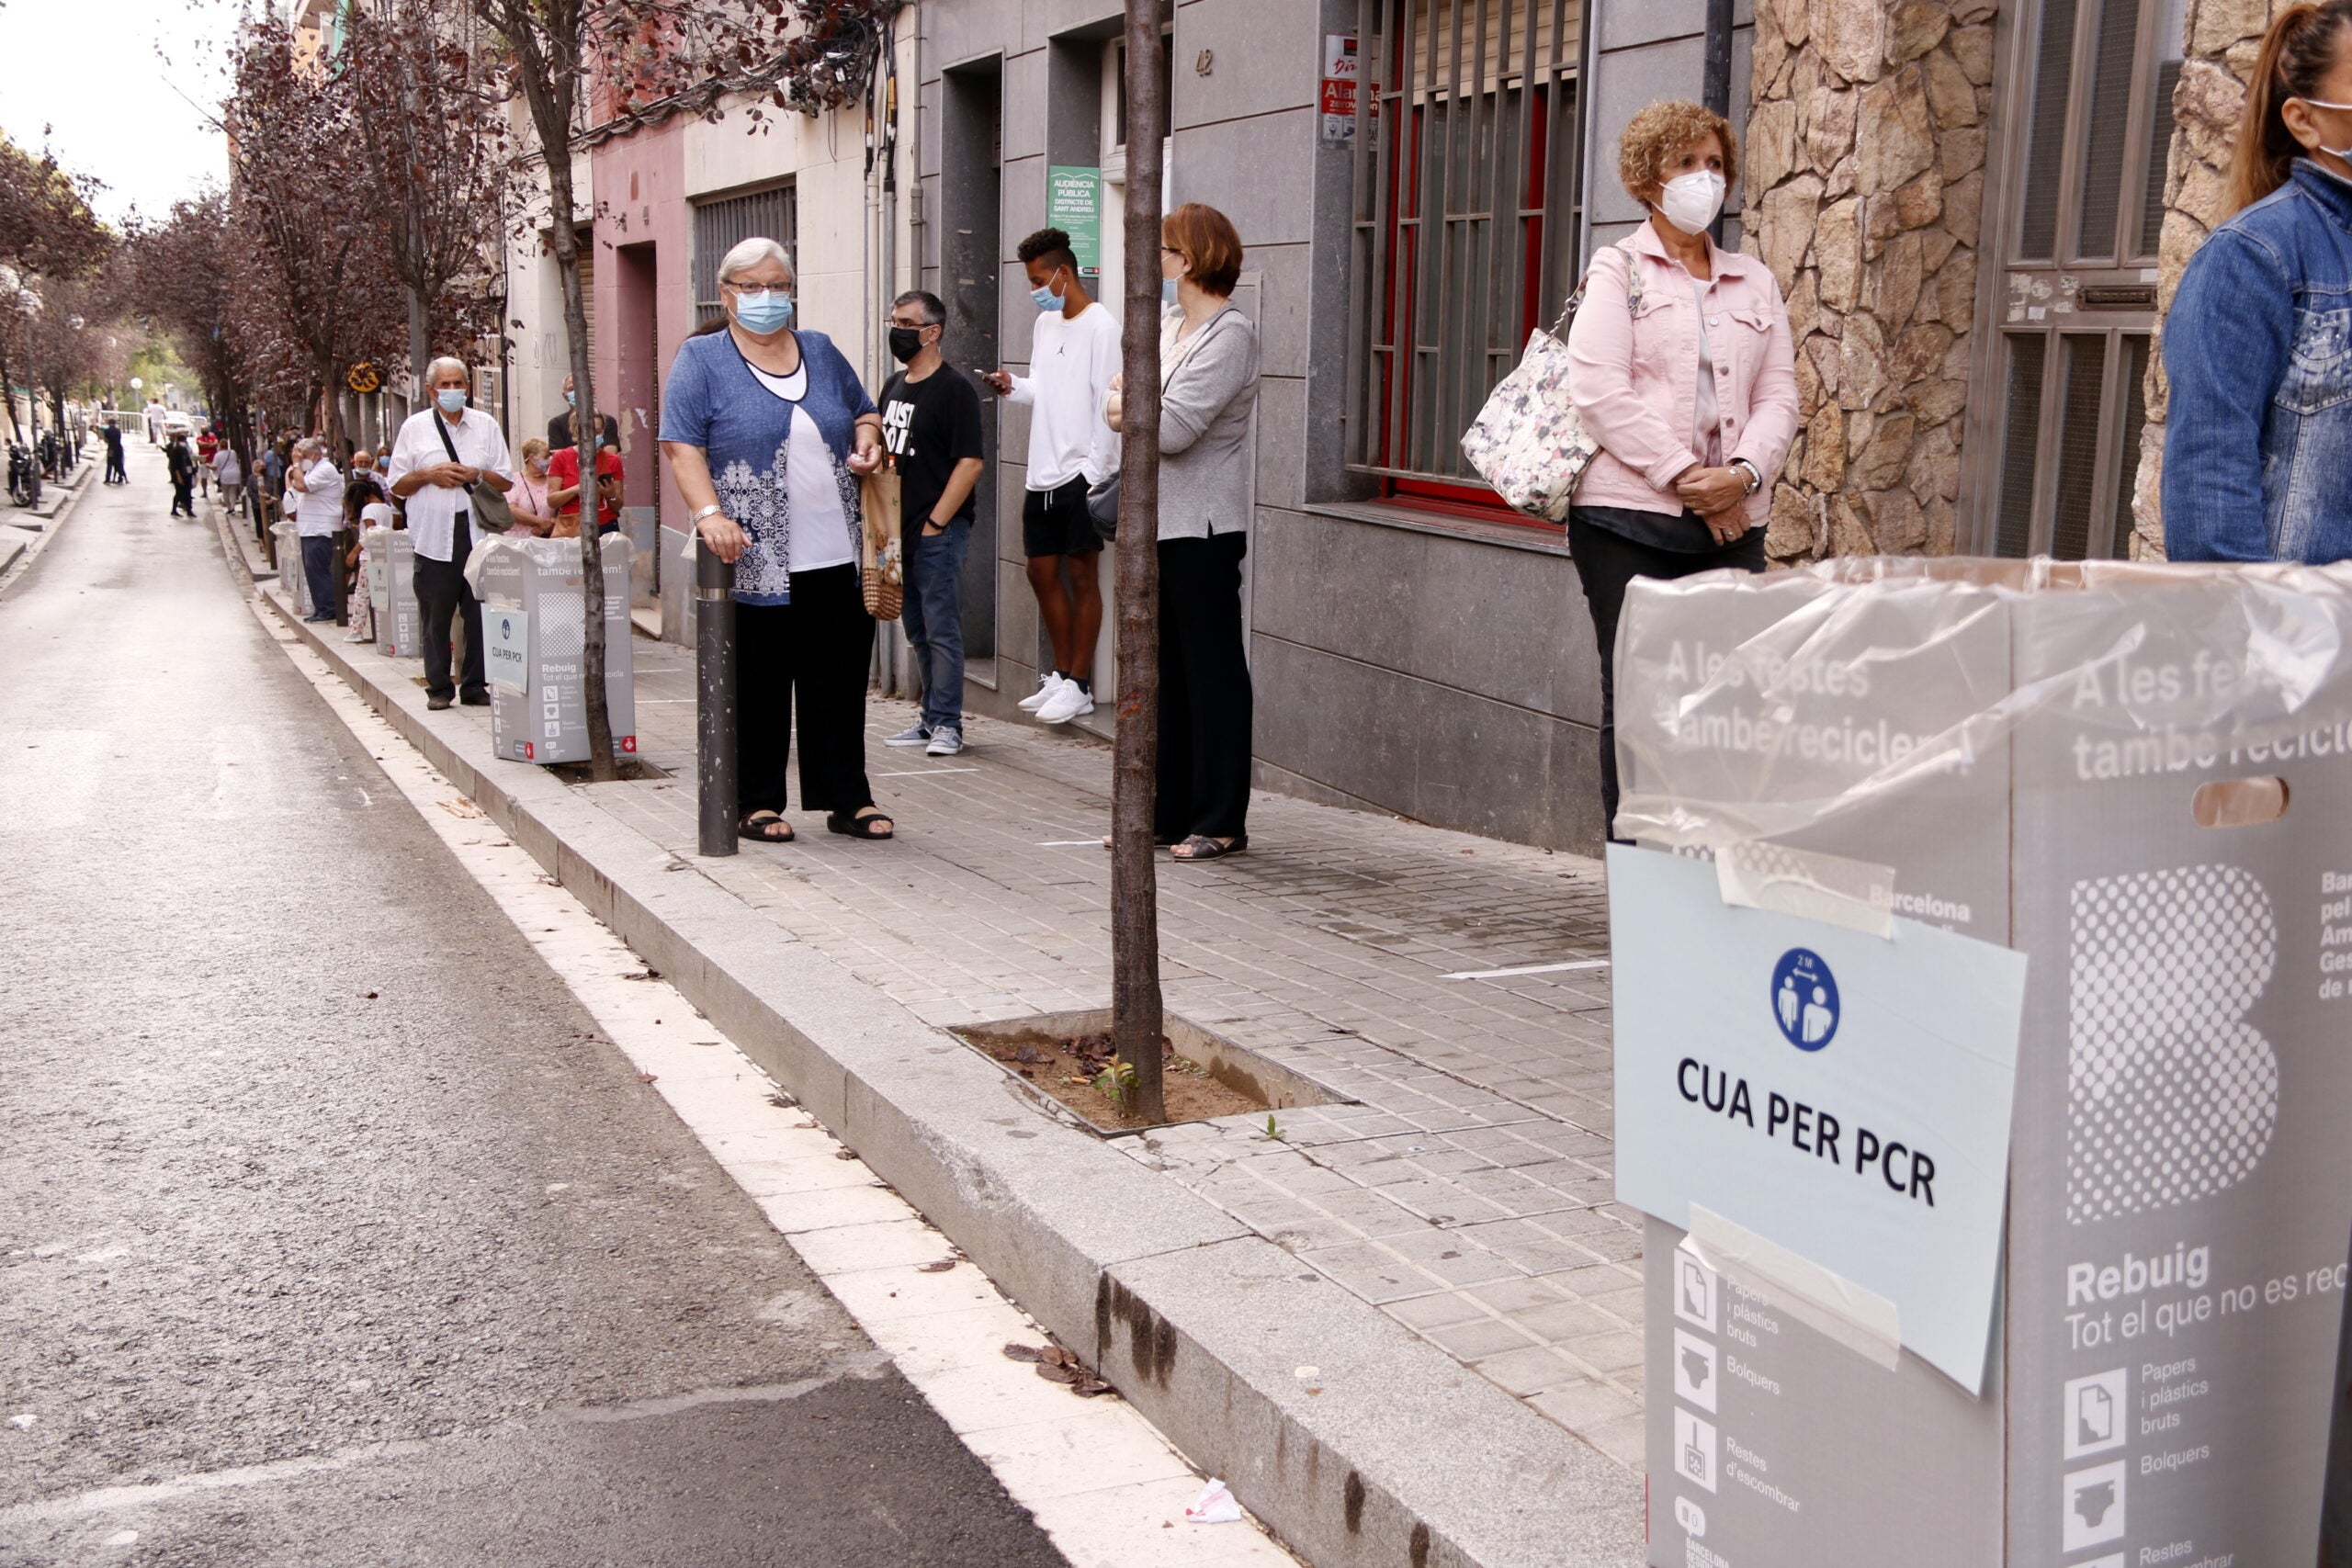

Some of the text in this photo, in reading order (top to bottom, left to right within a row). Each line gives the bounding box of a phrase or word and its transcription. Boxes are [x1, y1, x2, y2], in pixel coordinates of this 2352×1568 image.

[1054, 178, 1094, 188] AUDIÈNCIA
[1057, 188, 1091, 197] PÚBLICA
[882, 400, 915, 429] JUST
[492, 647, 522, 663] CUA PER PCR
[541, 662, 576, 673] Rebuig
[1666, 641, 1689, 683] A
[2073, 659, 2105, 710] A
[2117, 655, 2182, 705] les
[1870, 884, 1971, 922] Barcelona
[2320, 896, 2350, 925] pel
[1797, 954, 1814, 969] 2 M
[2318, 977, 2343, 999] de
[1677, 1057, 1935, 1207] CUA PER PCR
[2067, 1242, 2210, 1306] Rebuig
[1726, 1296, 1731, 1313] i
[1727, 1274, 1770, 1306] Papers
[2064, 1311, 2112, 1351] Tot
[2120, 1299, 2147, 1338] el
[2155, 1295, 2211, 1337] que
[2220, 1284, 2256, 1315] no
[2264, 1273, 2298, 1304] es
[1726, 1319, 1758, 1348] bruts
[1726, 1355, 1781, 1396] Bolquers
[2142, 1357, 2197, 1382] Papers
[2141, 1391, 2146, 1409] i
[2141, 1412, 2181, 1435] bruts
[1726, 1436, 1768, 1472] Restes
[2141, 1443, 2210, 1475] Bolquers
[1726, 1460, 1801, 1514] d'escombrar
[2139, 1540, 2193, 1567] Restes
